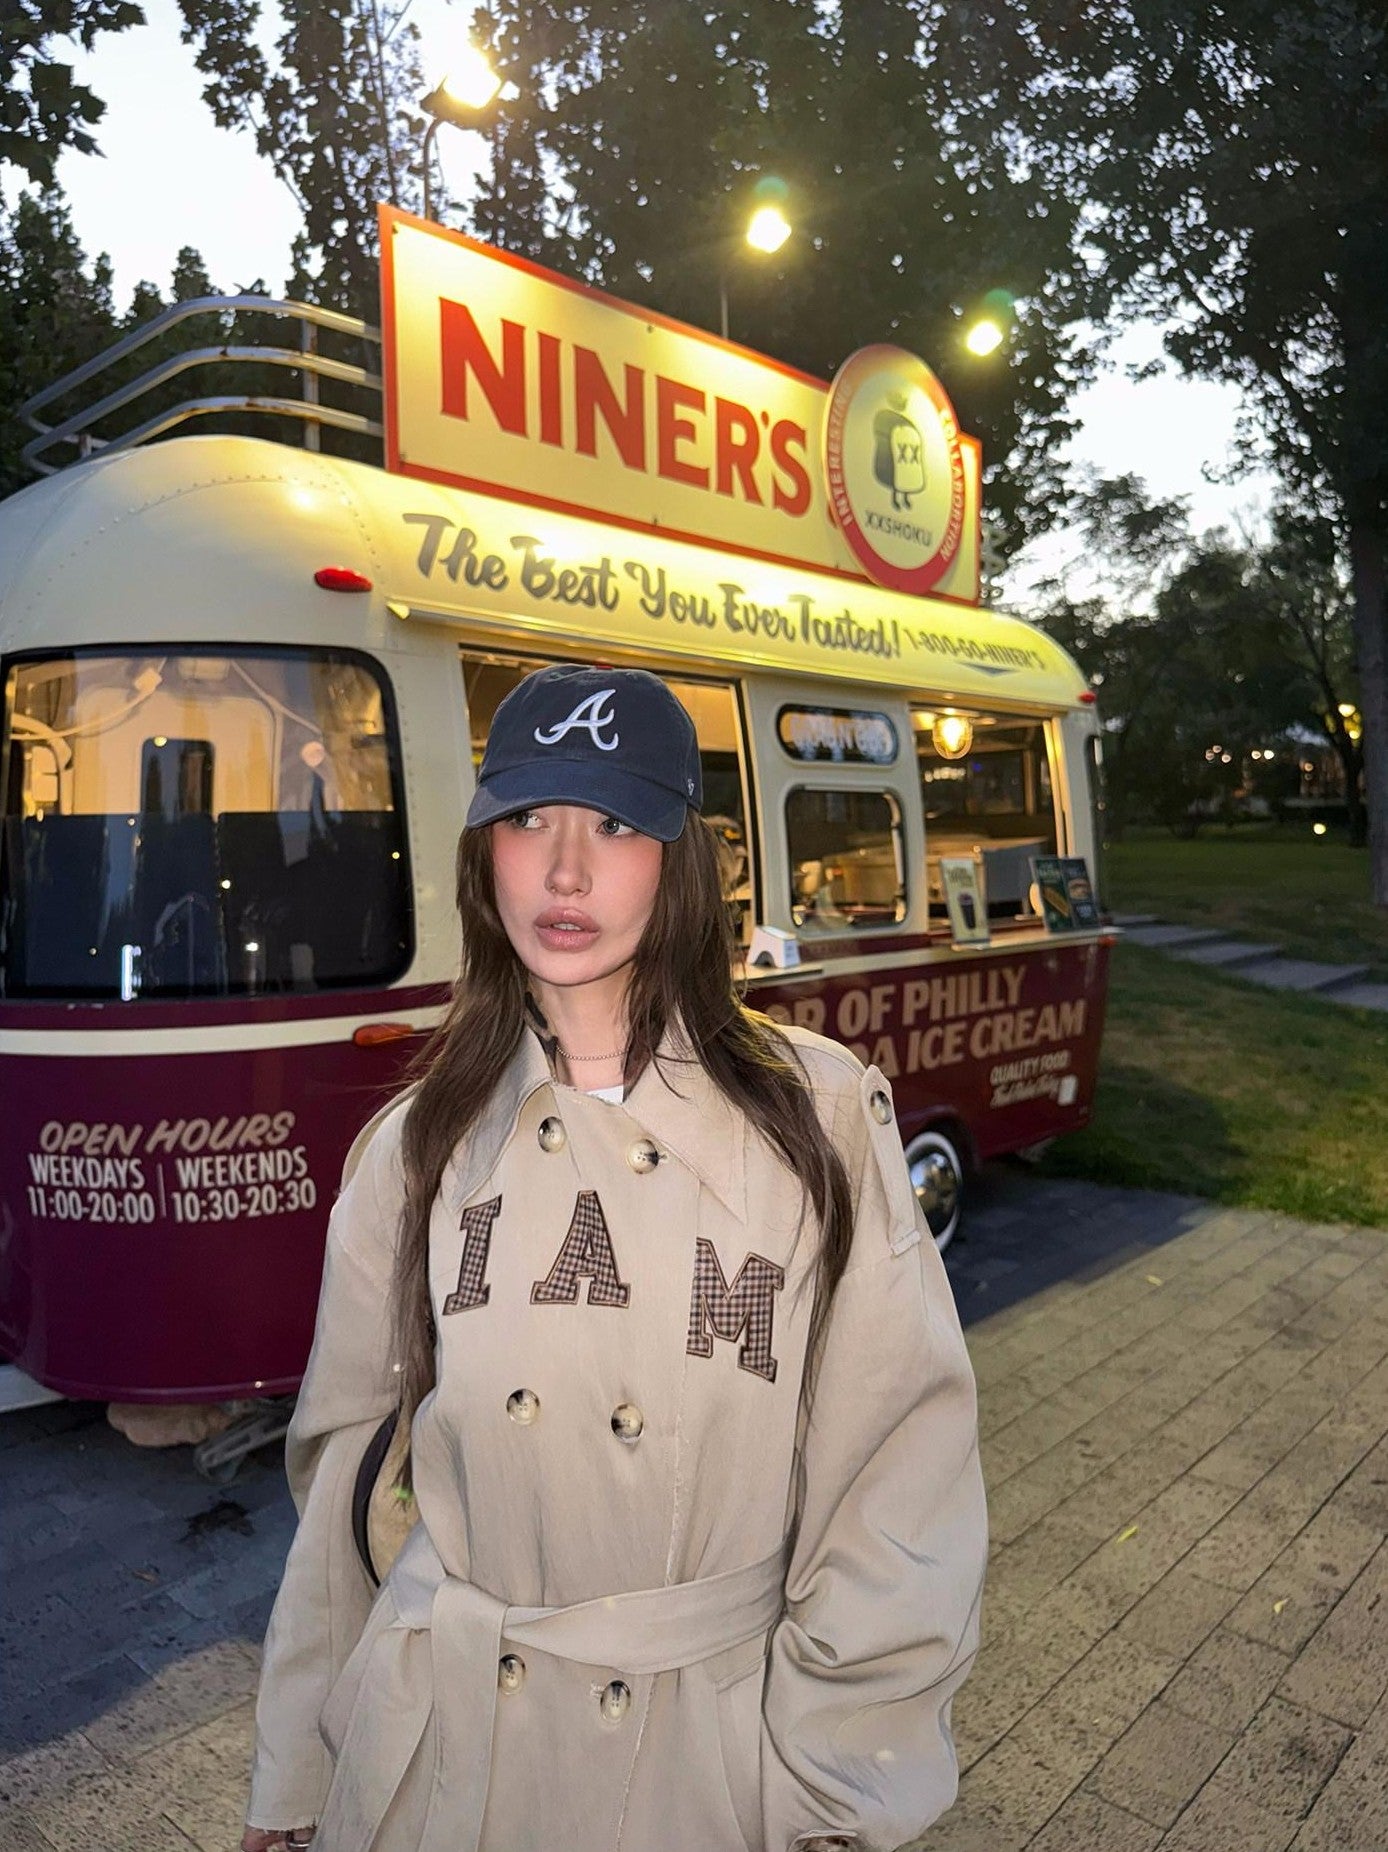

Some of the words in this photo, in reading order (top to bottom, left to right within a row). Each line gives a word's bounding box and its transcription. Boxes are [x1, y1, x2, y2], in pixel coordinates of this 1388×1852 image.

[438, 296, 813, 519] NINER'S
[864, 510, 933, 548] XXSHOKU
[402, 513, 510, 592] The
[509, 535, 620, 613] Best
[623, 561, 716, 630] You
[718, 583, 796, 642] Ever
[788, 594, 901, 660] Tasted!
[533, 688, 620, 751] A
[837, 984, 896, 1039] OF
[901, 965, 1027, 1026] PHILLY
[906, 1022, 969, 1074] ICE
[969, 999, 1088, 1059] CREAM
[39, 1120, 144, 1157] OPEN
[145, 1110, 296, 1153] HOURS
[28, 1153, 146, 1190] WEEKDAYS
[174, 1145, 309, 1190] WEEKENDS
[27, 1185, 155, 1224] 11:00-20:00
[171, 1178, 317, 1223] 10:30-20:30
